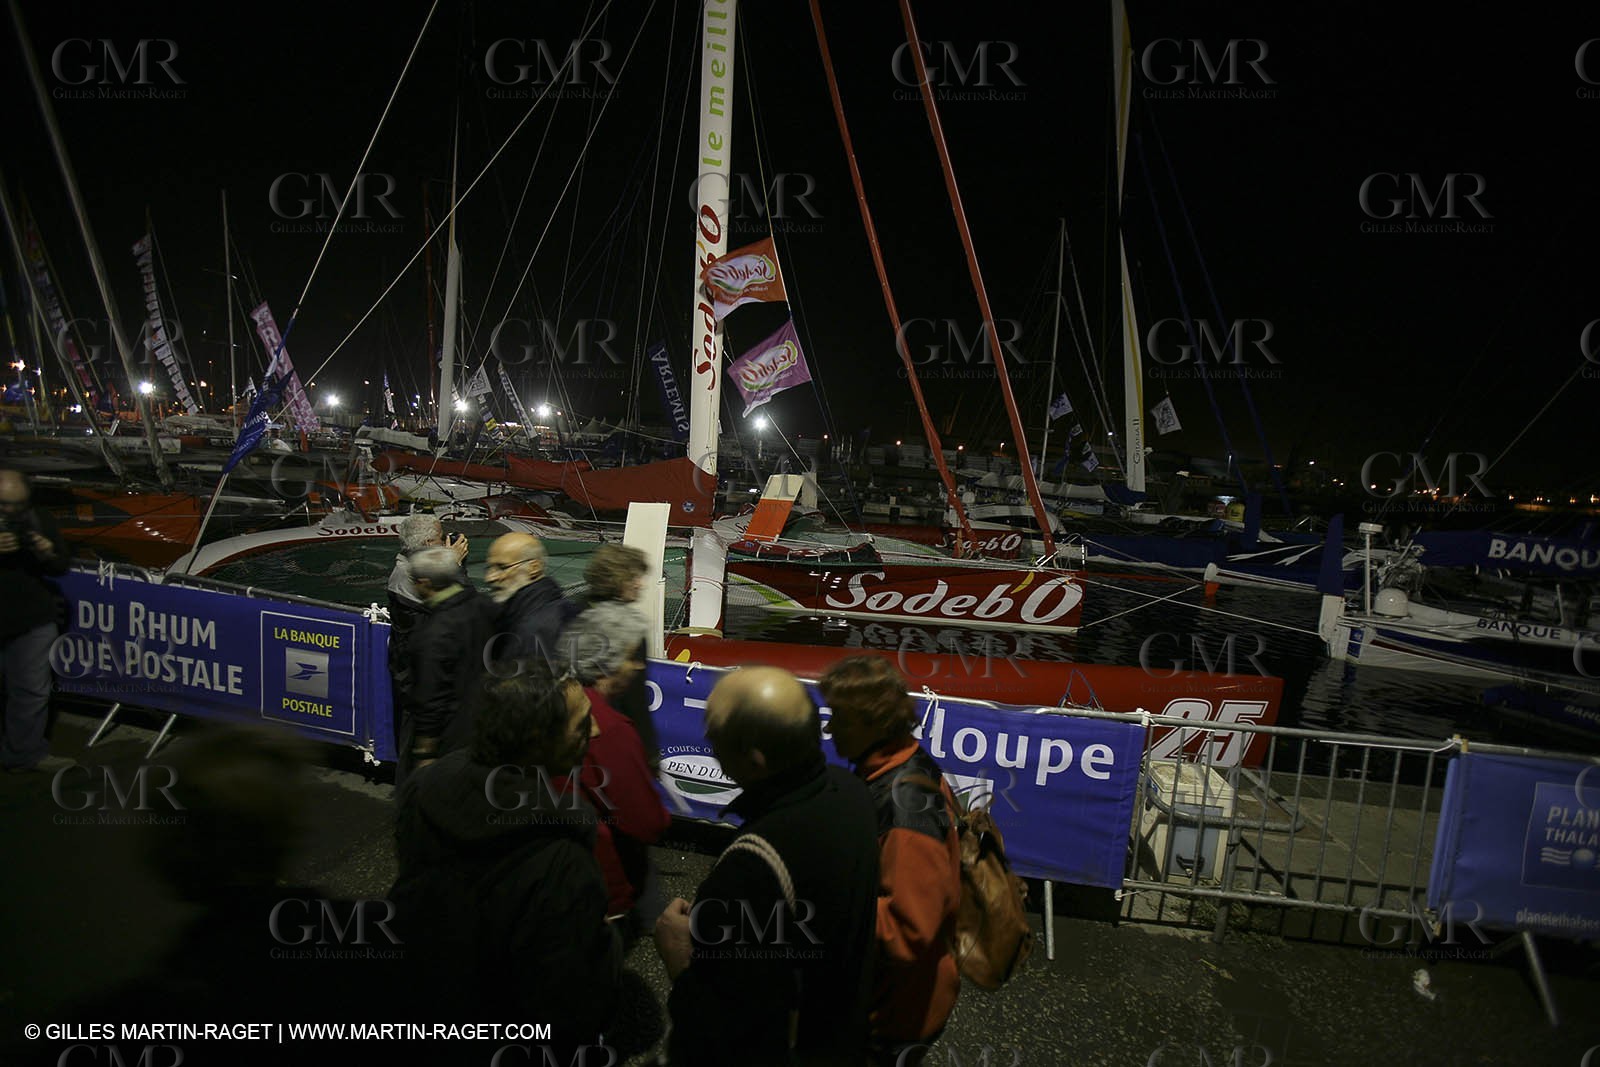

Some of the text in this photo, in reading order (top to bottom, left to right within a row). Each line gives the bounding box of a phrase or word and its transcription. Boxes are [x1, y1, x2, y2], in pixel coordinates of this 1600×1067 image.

[702, 0, 727, 167] le meill
[694, 204, 721, 390] Sodb'O
[825, 571, 1084, 624] Sodeb'O
[78, 600, 217, 650] DU RHUM
[274, 626, 341, 649] LA BANQUE
[1476, 618, 1561, 640] BANQUE
[125, 641, 244, 696] POSTALE
[282, 697, 333, 718] POSTALE
[667, 744, 701, 754] course
[1146, 698, 1269, 769] 25
[667, 761, 695, 777] PEN
